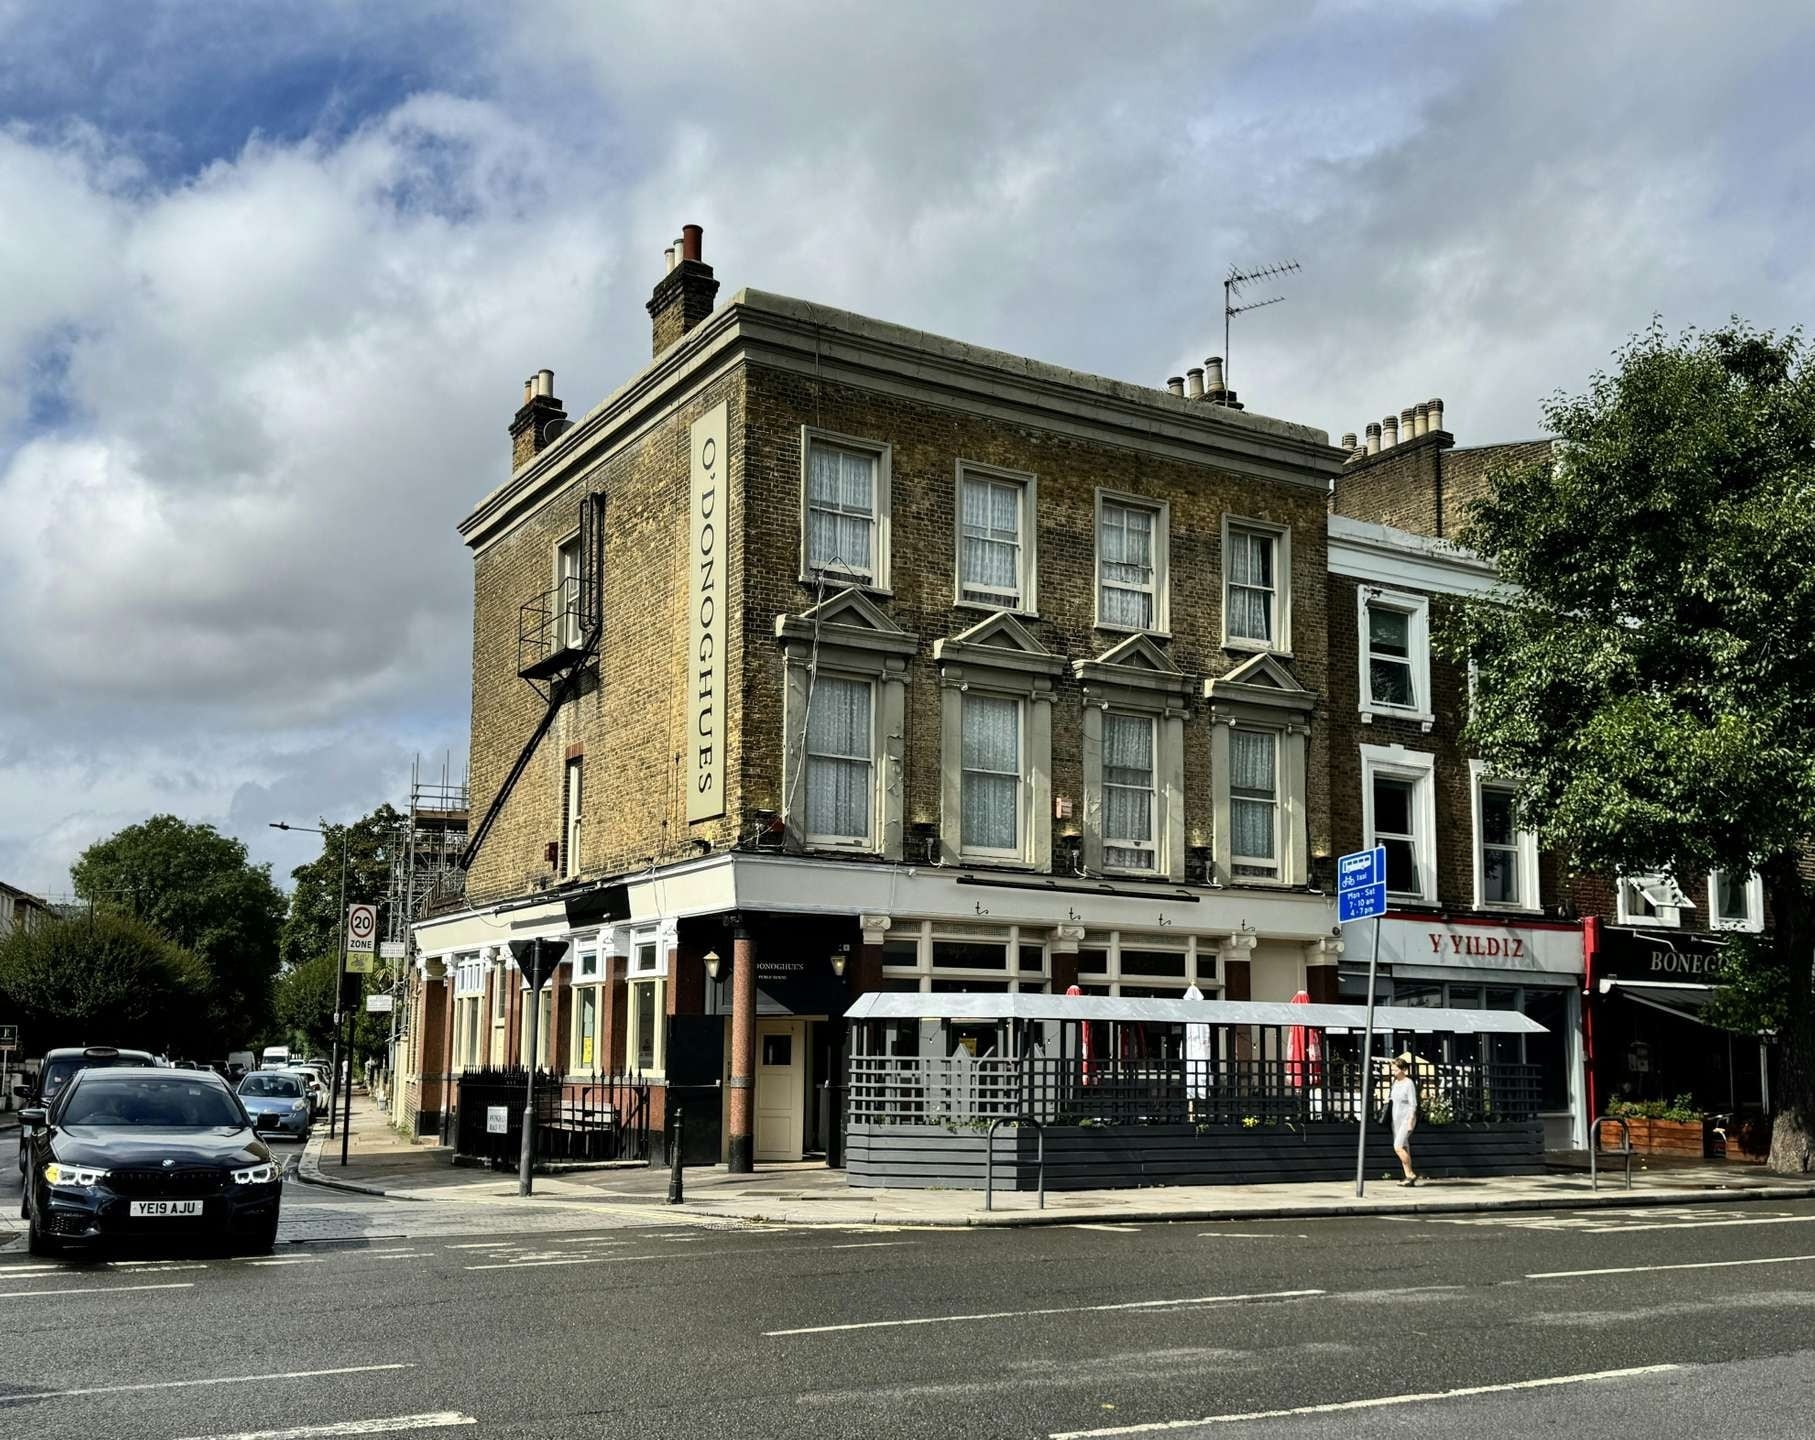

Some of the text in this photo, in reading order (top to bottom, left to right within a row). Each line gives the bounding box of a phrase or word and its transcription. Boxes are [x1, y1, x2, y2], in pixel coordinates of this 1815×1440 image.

[698, 437, 716, 794] O'DONOGHUES
[1348, 892, 1360, 900] Mon
[1365, 888, 1375, 896] Sat
[354, 916, 370, 929] 20
[350, 940, 372, 949] ZONE
[1428, 933, 1524, 958] Y YILDIZ
[139, 1202, 195, 1214] YE19 AJU
